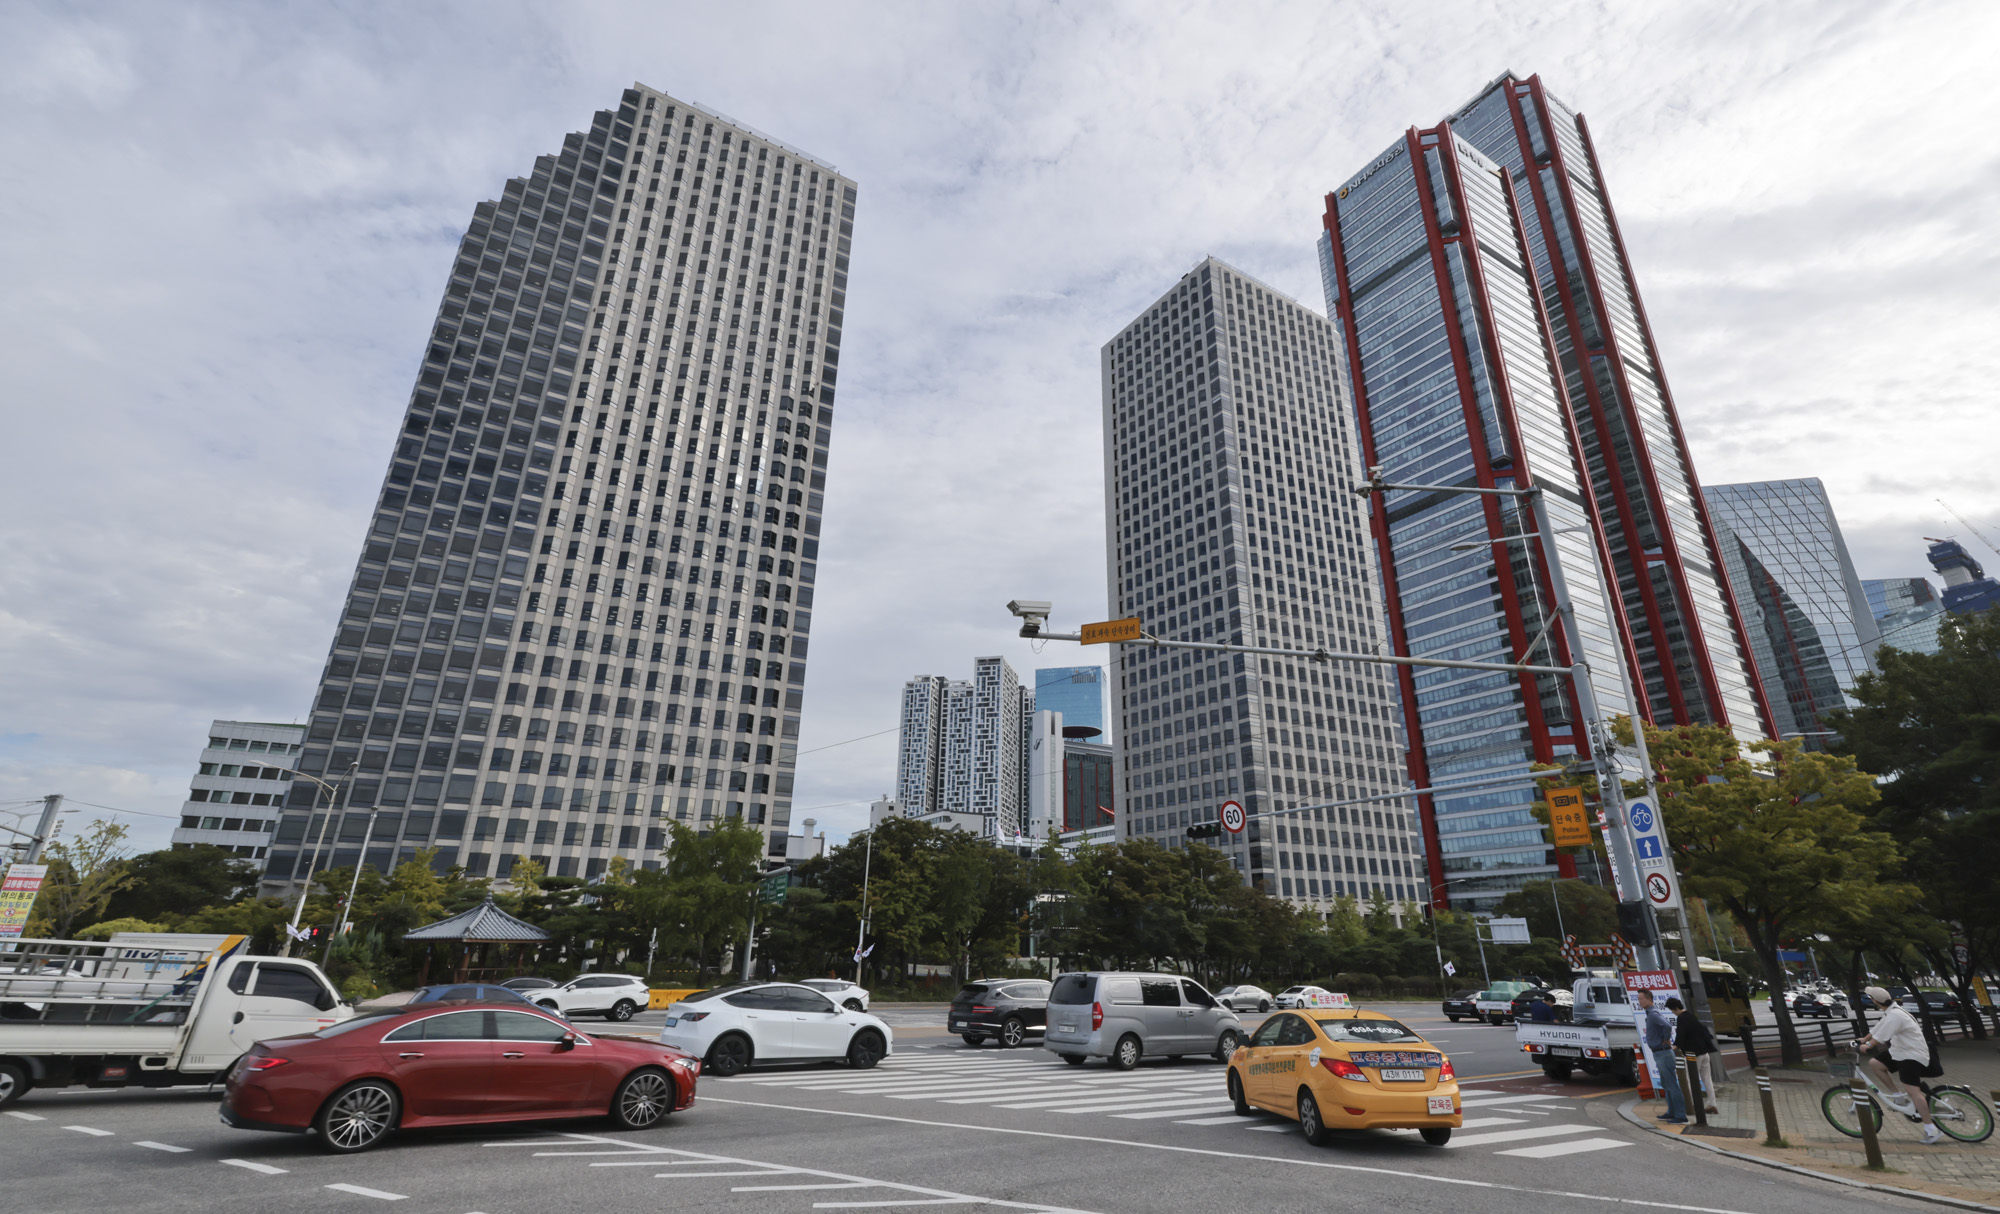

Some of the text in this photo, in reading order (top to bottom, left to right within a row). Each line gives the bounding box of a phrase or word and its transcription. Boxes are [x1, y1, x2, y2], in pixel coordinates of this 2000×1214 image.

[1225, 809, 1240, 825] 60
[1556, 813, 1582, 824] 단속중
[4, 880, 41, 889] 교통통제안내
[1, 891, 34, 900] 여의동로
[1627, 974, 1673, 989] 교통통제안내
[1318, 995, 1343, 1004] 도로주행
[1540, 1030, 1581, 1040] HYUNDAI
[1351, 1052, 1440, 1063] 교육중입니다
[1402, 1071, 1420, 1079] 0117
[1430, 1099, 1452, 1110] 교육중
